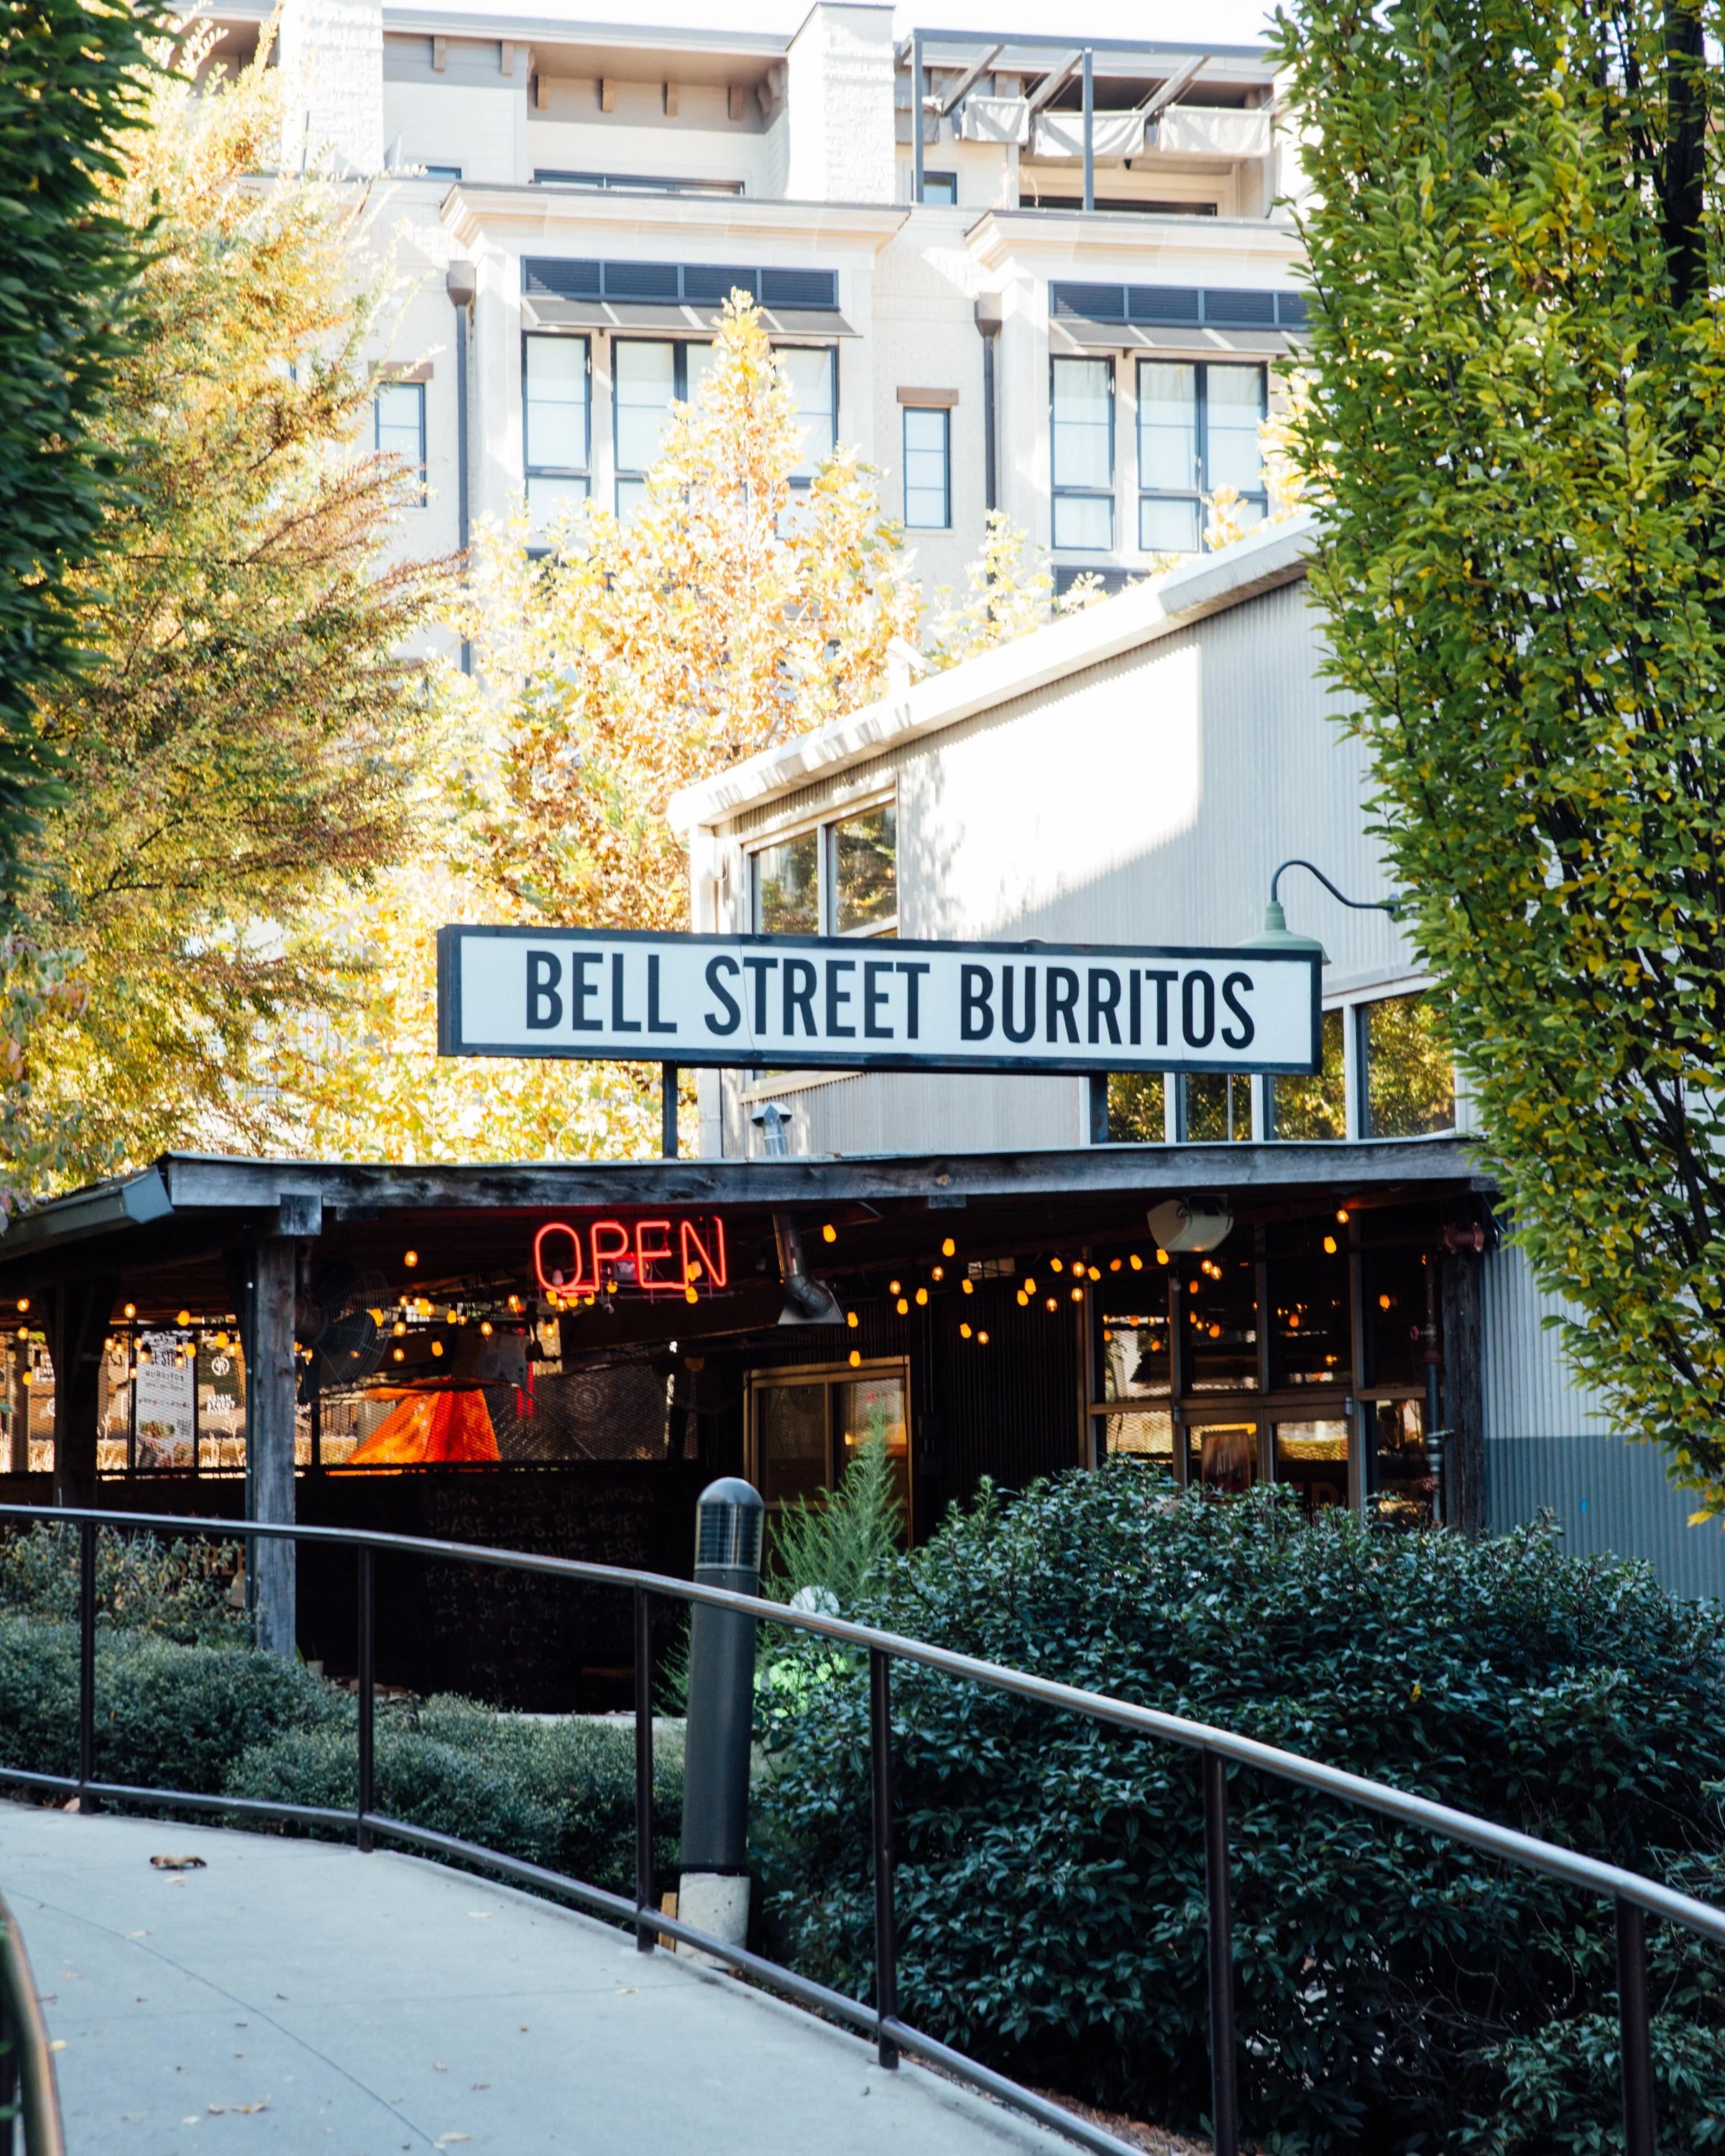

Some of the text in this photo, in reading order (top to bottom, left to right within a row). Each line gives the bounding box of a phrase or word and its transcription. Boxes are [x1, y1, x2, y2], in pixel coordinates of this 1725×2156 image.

[528, 952, 1254, 1049] BELL STREET BURRITOS
[535, 1217, 726, 1293] OPEN
